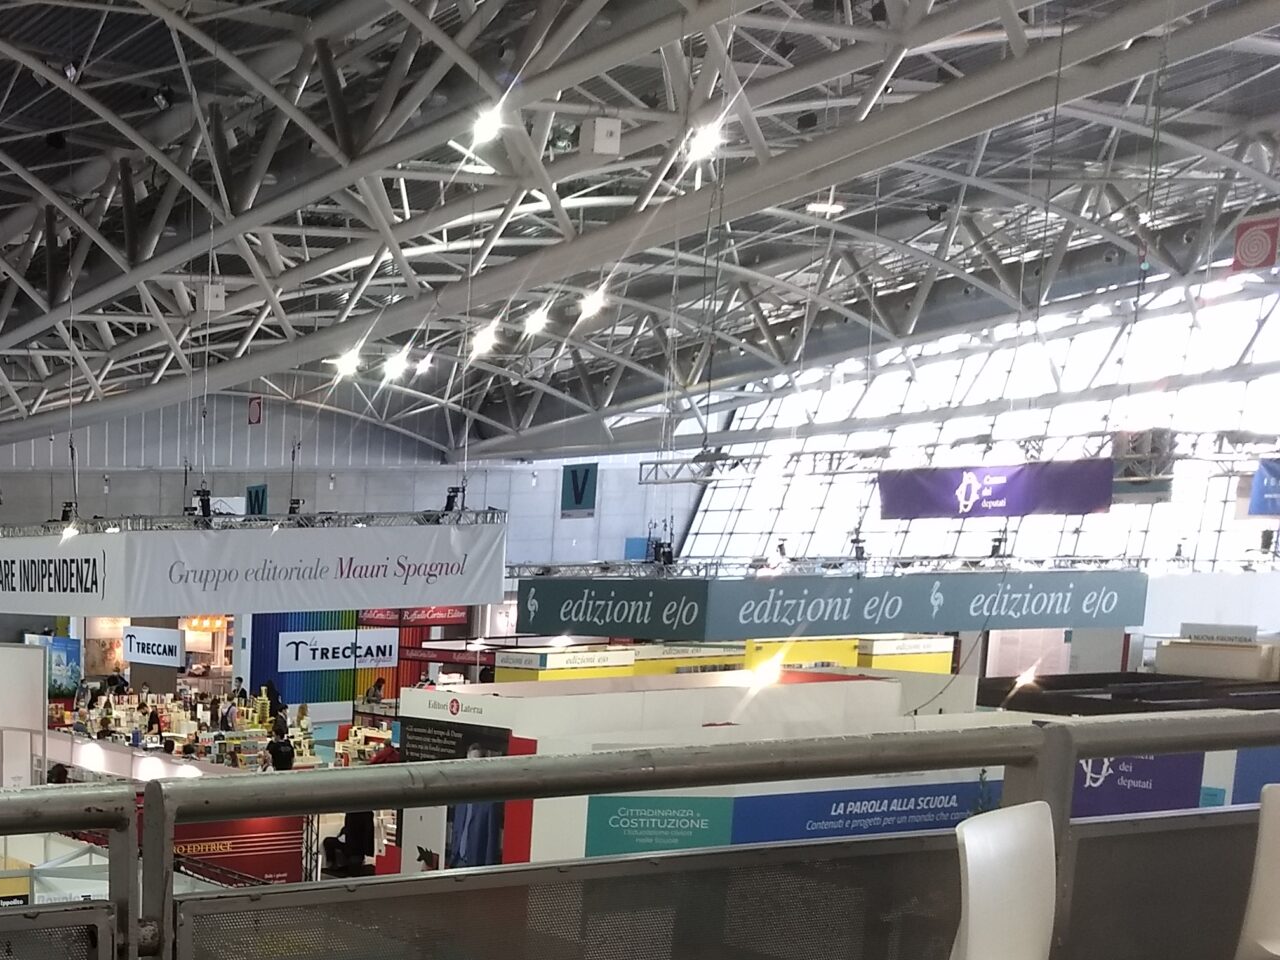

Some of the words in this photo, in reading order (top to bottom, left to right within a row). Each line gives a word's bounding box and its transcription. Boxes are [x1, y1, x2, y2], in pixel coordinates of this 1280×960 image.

[571, 469, 590, 505] V
[248, 489, 265, 514] W
[19, 558, 98, 593] INDIPENDENZA
[168, 560, 238, 591] Gruppo
[244, 558, 330, 582] editoriale
[334, 557, 389, 580] Mauri
[393, 554, 467, 585] Spagnol
[560, 589, 654, 625] edizioni
[662, 596, 699, 630] e/o
[738, 585, 853, 625] edizioni
[863, 589, 903, 625] e/o
[969, 583, 1072, 618] edizioni
[1082, 586, 1118, 616] e/o
[136, 641, 177, 657] TRECCANI
[310, 644, 393, 660] TRECCANI
[428, 700, 448, 710] Editori
[1119, 762, 1133, 772] dei
[1117, 776, 1152, 789] deputati
[831, 803, 844, 816] LA
[846, 800, 888, 814] PAROLA
[889, 798, 915, 812] ALLA
[806, 818, 844, 830] Contenuti
[851, 816, 882, 830] progetti
[882, 815, 896, 828] per
[187, 841, 233, 853] EDITRICE
